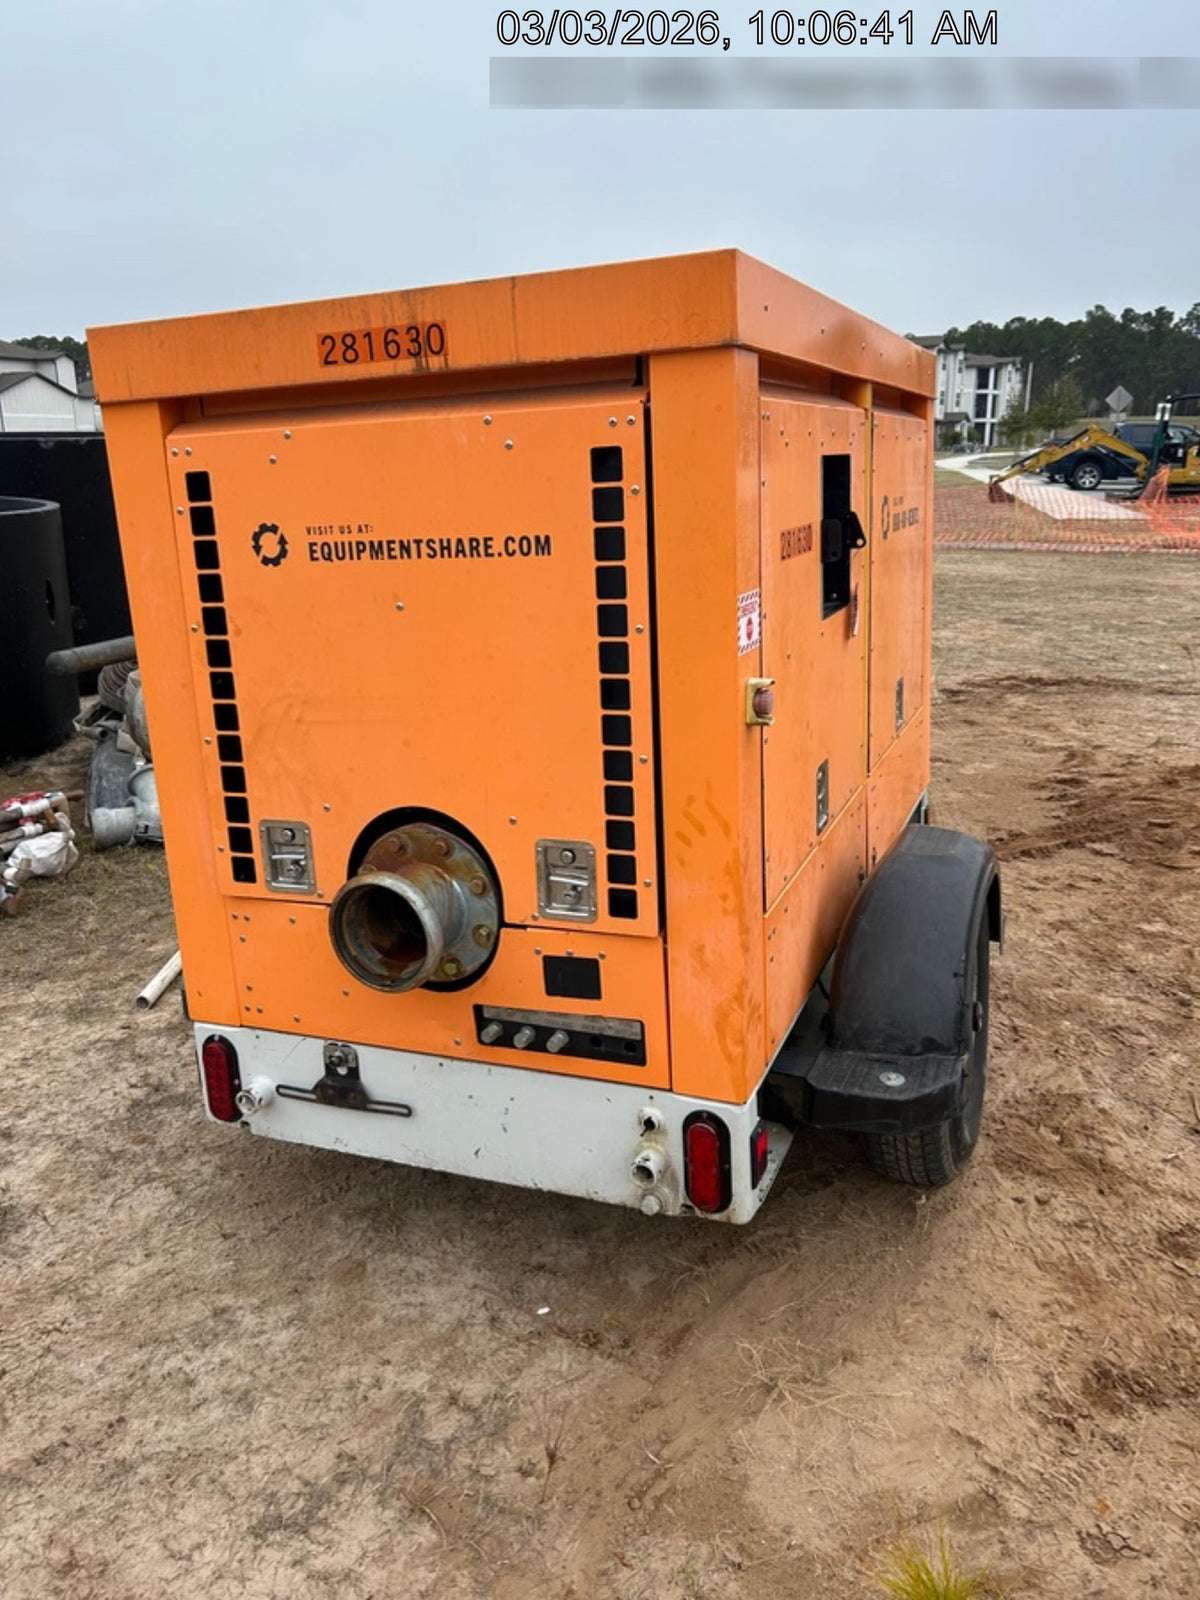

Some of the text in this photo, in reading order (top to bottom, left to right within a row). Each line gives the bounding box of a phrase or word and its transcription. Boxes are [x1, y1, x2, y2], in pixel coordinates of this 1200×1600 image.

[320, 323, 445, 366] 281630
[305, 523, 375, 536] VISIT US AT:
[308, 534, 552, 563] EQUIPMENTSHARE.COM
